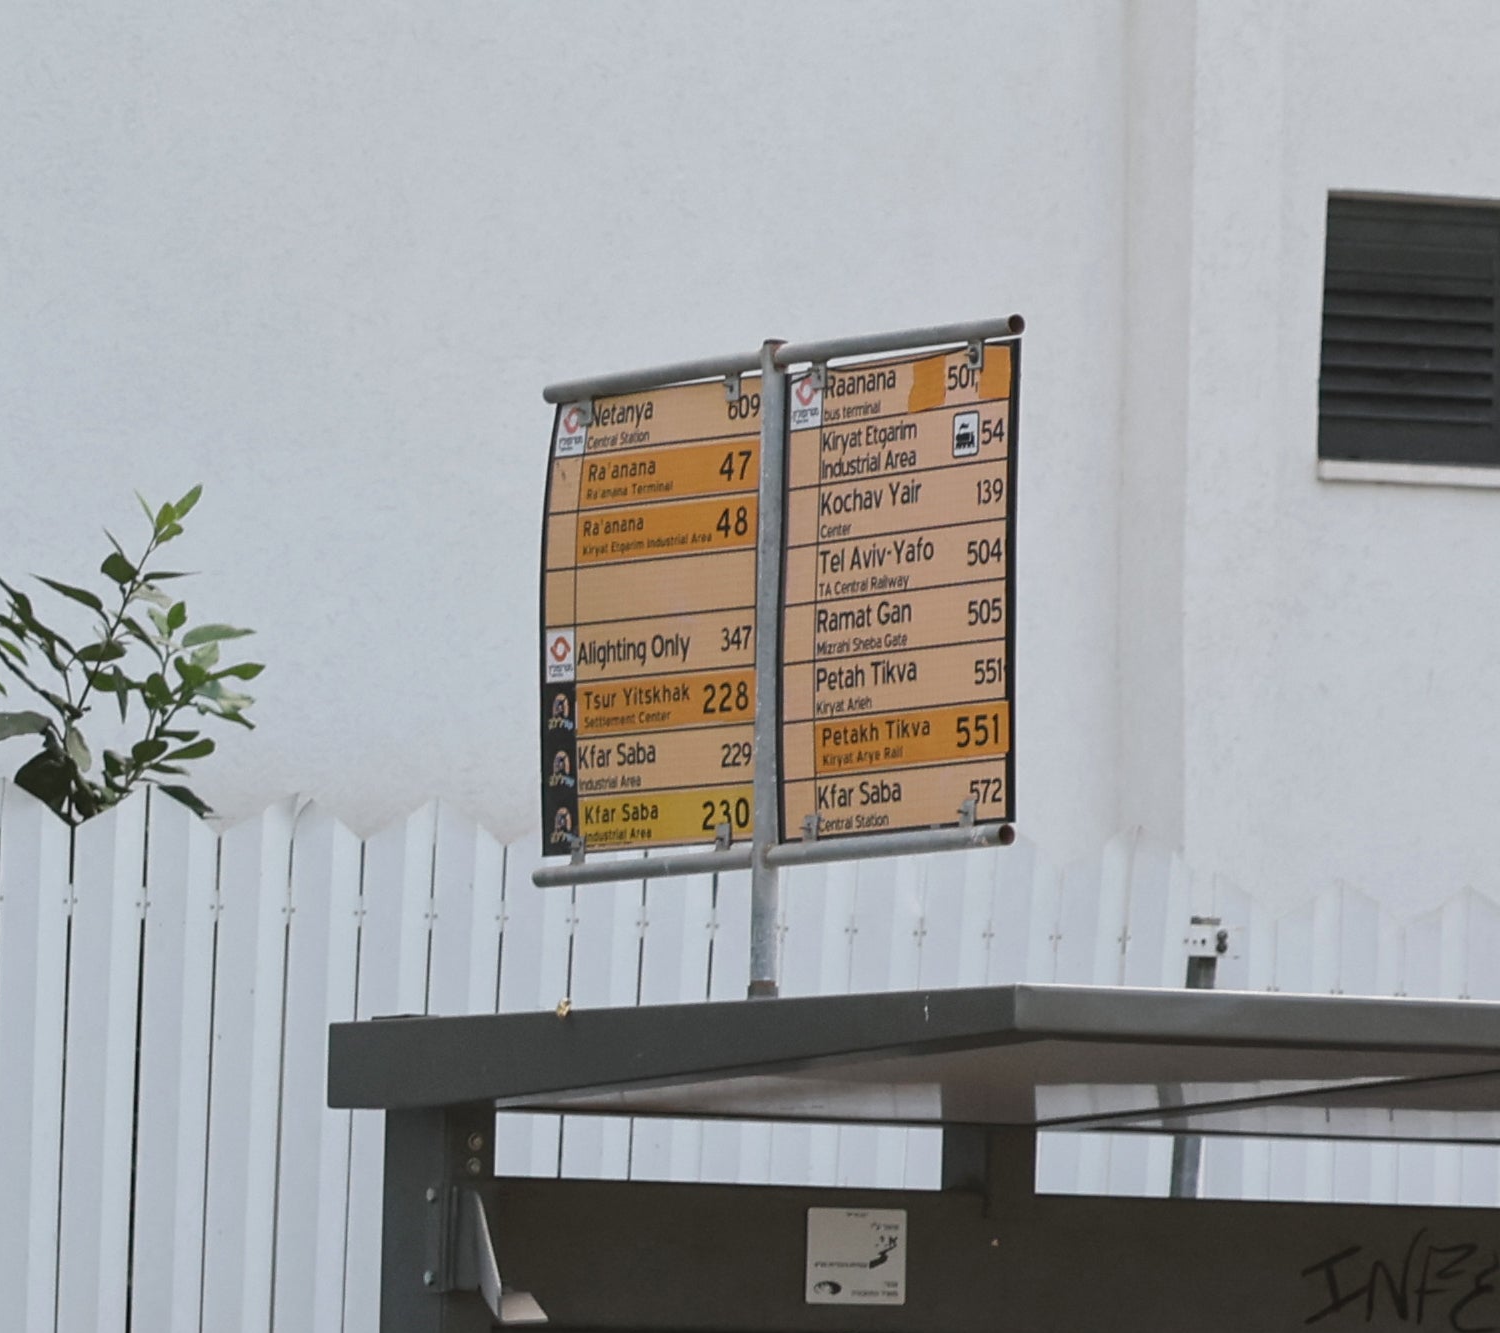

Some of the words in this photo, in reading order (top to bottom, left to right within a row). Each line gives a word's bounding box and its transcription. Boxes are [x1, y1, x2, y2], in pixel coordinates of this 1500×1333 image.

[825, 369, 896, 399] Raanana
[588, 401, 653, 428] Netanya
[728, 393, 760, 420] 609
[843, 401, 881, 418] terminal
[587, 433, 618, 449] Central
[621, 430, 650, 445] Station
[822, 429, 863, 455] Kiryat
[866, 420, 918, 450] Etgarim
[981, 418, 1005, 445] 54
[719, 450, 752, 482] 47
[821, 452, 880, 479] Industrial
[884, 449, 917, 470] Area
[632, 481, 674, 494] Terminal
[820, 488, 884, 517] Kochav
[889, 479, 922, 507] Yair
[977, 478, 1004, 506] 139
[716, 505, 748, 538] 48
[820, 523, 852, 539] Center
[819, 547, 845, 575] Tel
[850, 537, 935, 571] Aviv-Yafo
[967, 537, 1002, 567] 504
[819, 582, 832, 598] TA
[834, 578, 868, 595] Central
[871, 574, 909, 591] Railway
[817, 605, 872, 633] Ramat
[877, 601, 912, 625] Gan
[968, 597, 1002, 626] 505
[577, 637, 647, 671] Alighting
[651, 633, 691, 662] Only
[721, 625, 752, 652] 347
[884, 633, 908, 648] Gate
[816, 664, 865, 692] Petah
[871, 659, 918, 686] Tikva
[974, 657, 1002, 685] 551
[584, 691, 617, 710] Tsur
[622, 683, 690, 706] Yitskhak
[702, 681, 749, 714] 228
[816, 699, 844, 717] Kiryat
[822, 722, 879, 748] Petakh
[885, 719, 930, 740] Tikva
[956, 713, 999, 748] 551
[578, 744, 612, 770] Kfar
[617, 742, 656, 766] Saba
[721, 741, 752, 768] 229
[822, 753, 852, 767] Kiryat
[818, 783, 854, 810] Kfar
[860, 779, 902, 805] Saba
[970, 777, 1002, 805] 572
[585, 805, 616, 825] Kfar
[622, 803, 659, 822] Saba
[702, 797, 749, 831] 230
[855, 813, 890, 828] Station
